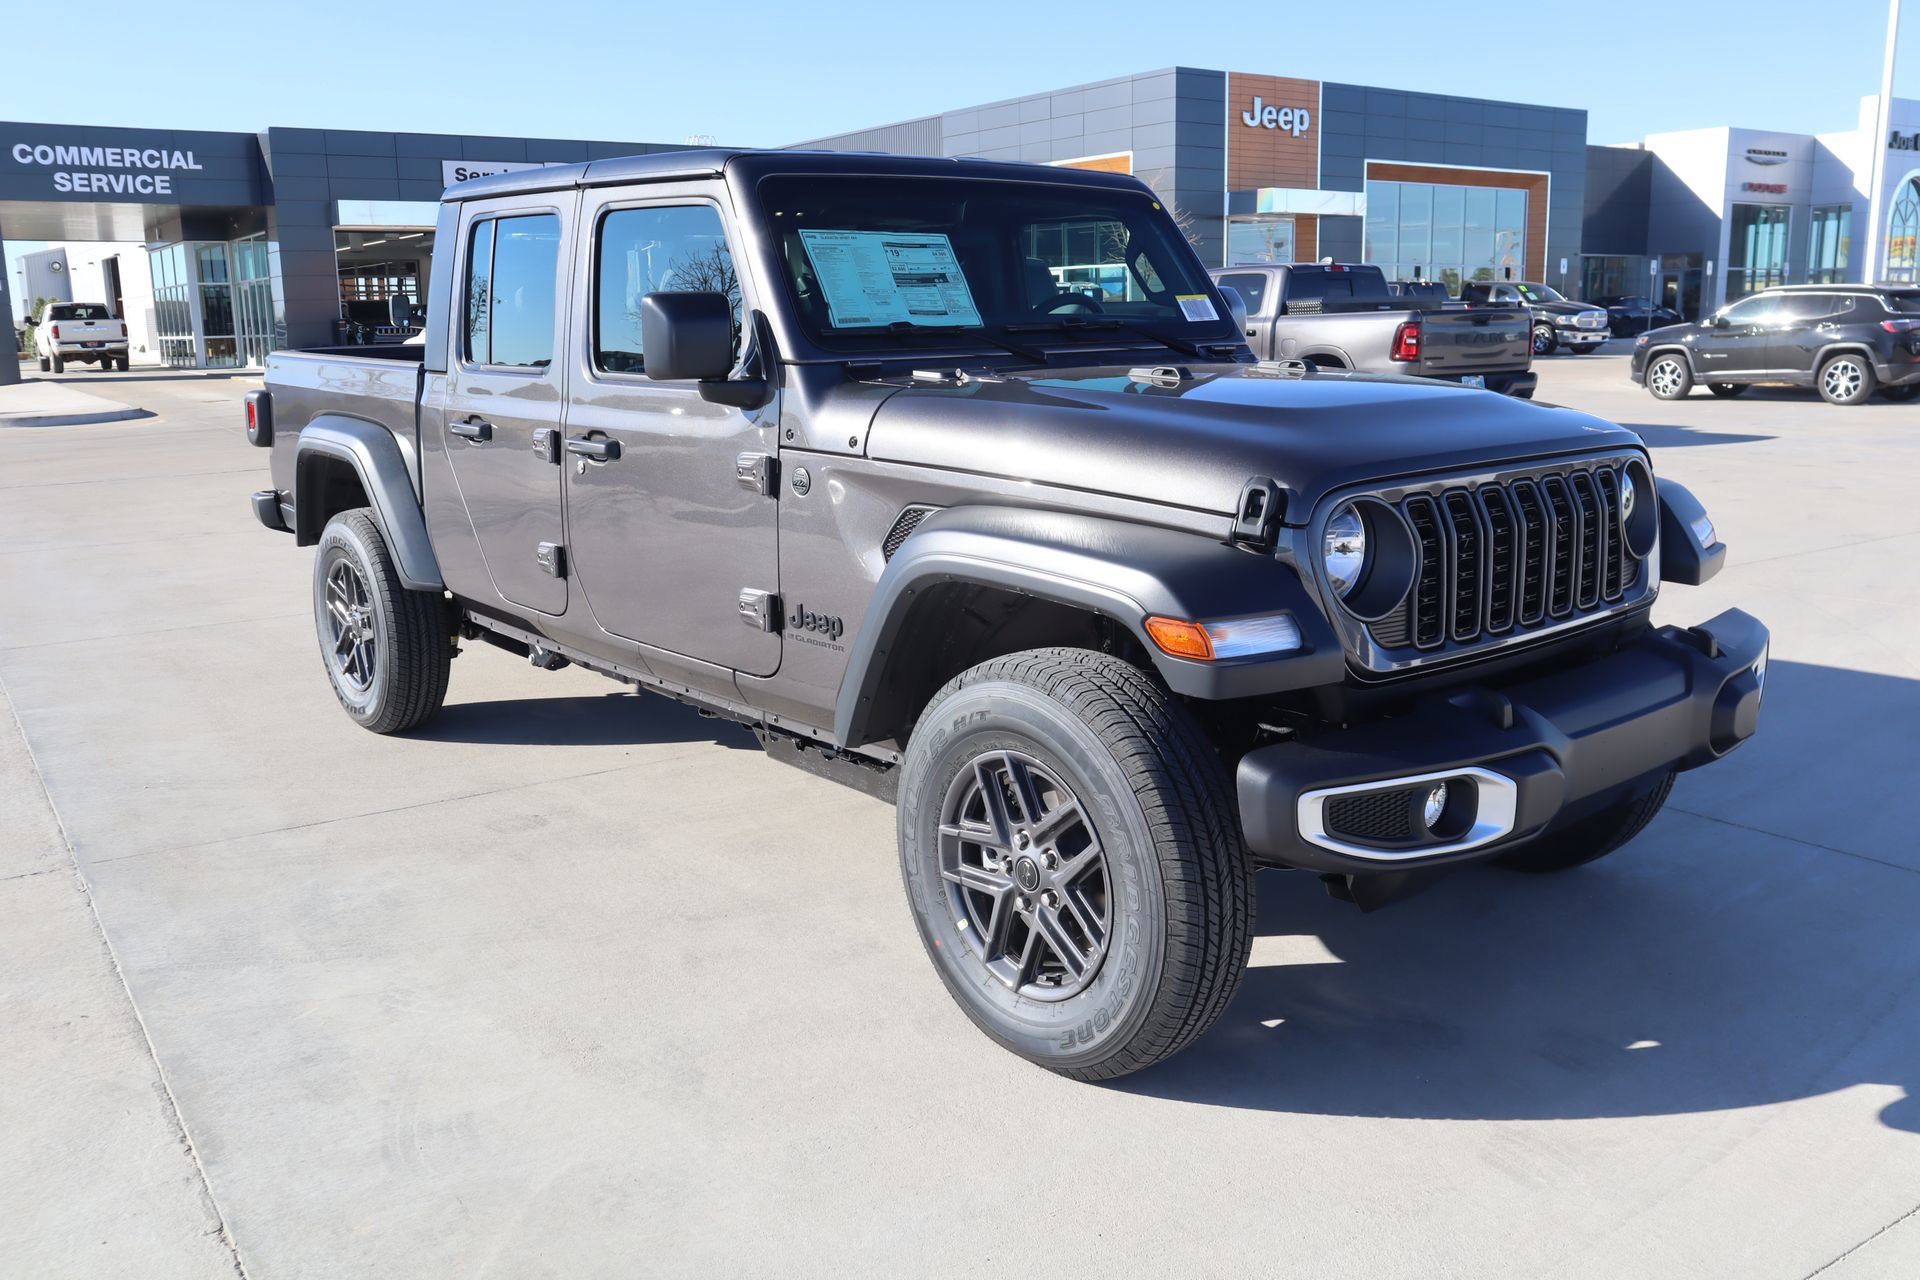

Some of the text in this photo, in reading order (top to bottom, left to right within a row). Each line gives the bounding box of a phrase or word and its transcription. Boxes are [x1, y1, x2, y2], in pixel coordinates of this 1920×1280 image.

[1242, 95, 1310, 137] Jeep
[12, 143, 203, 170] COMMERCIAL
[53, 172, 172, 194] SERVICE
[788, 603, 844, 641] Jeep
[795, 634, 845, 652] GLADIATOR
[953, 710, 991, 732] H/T
[1058, 793, 1142, 1050] BRIDGESTONE
